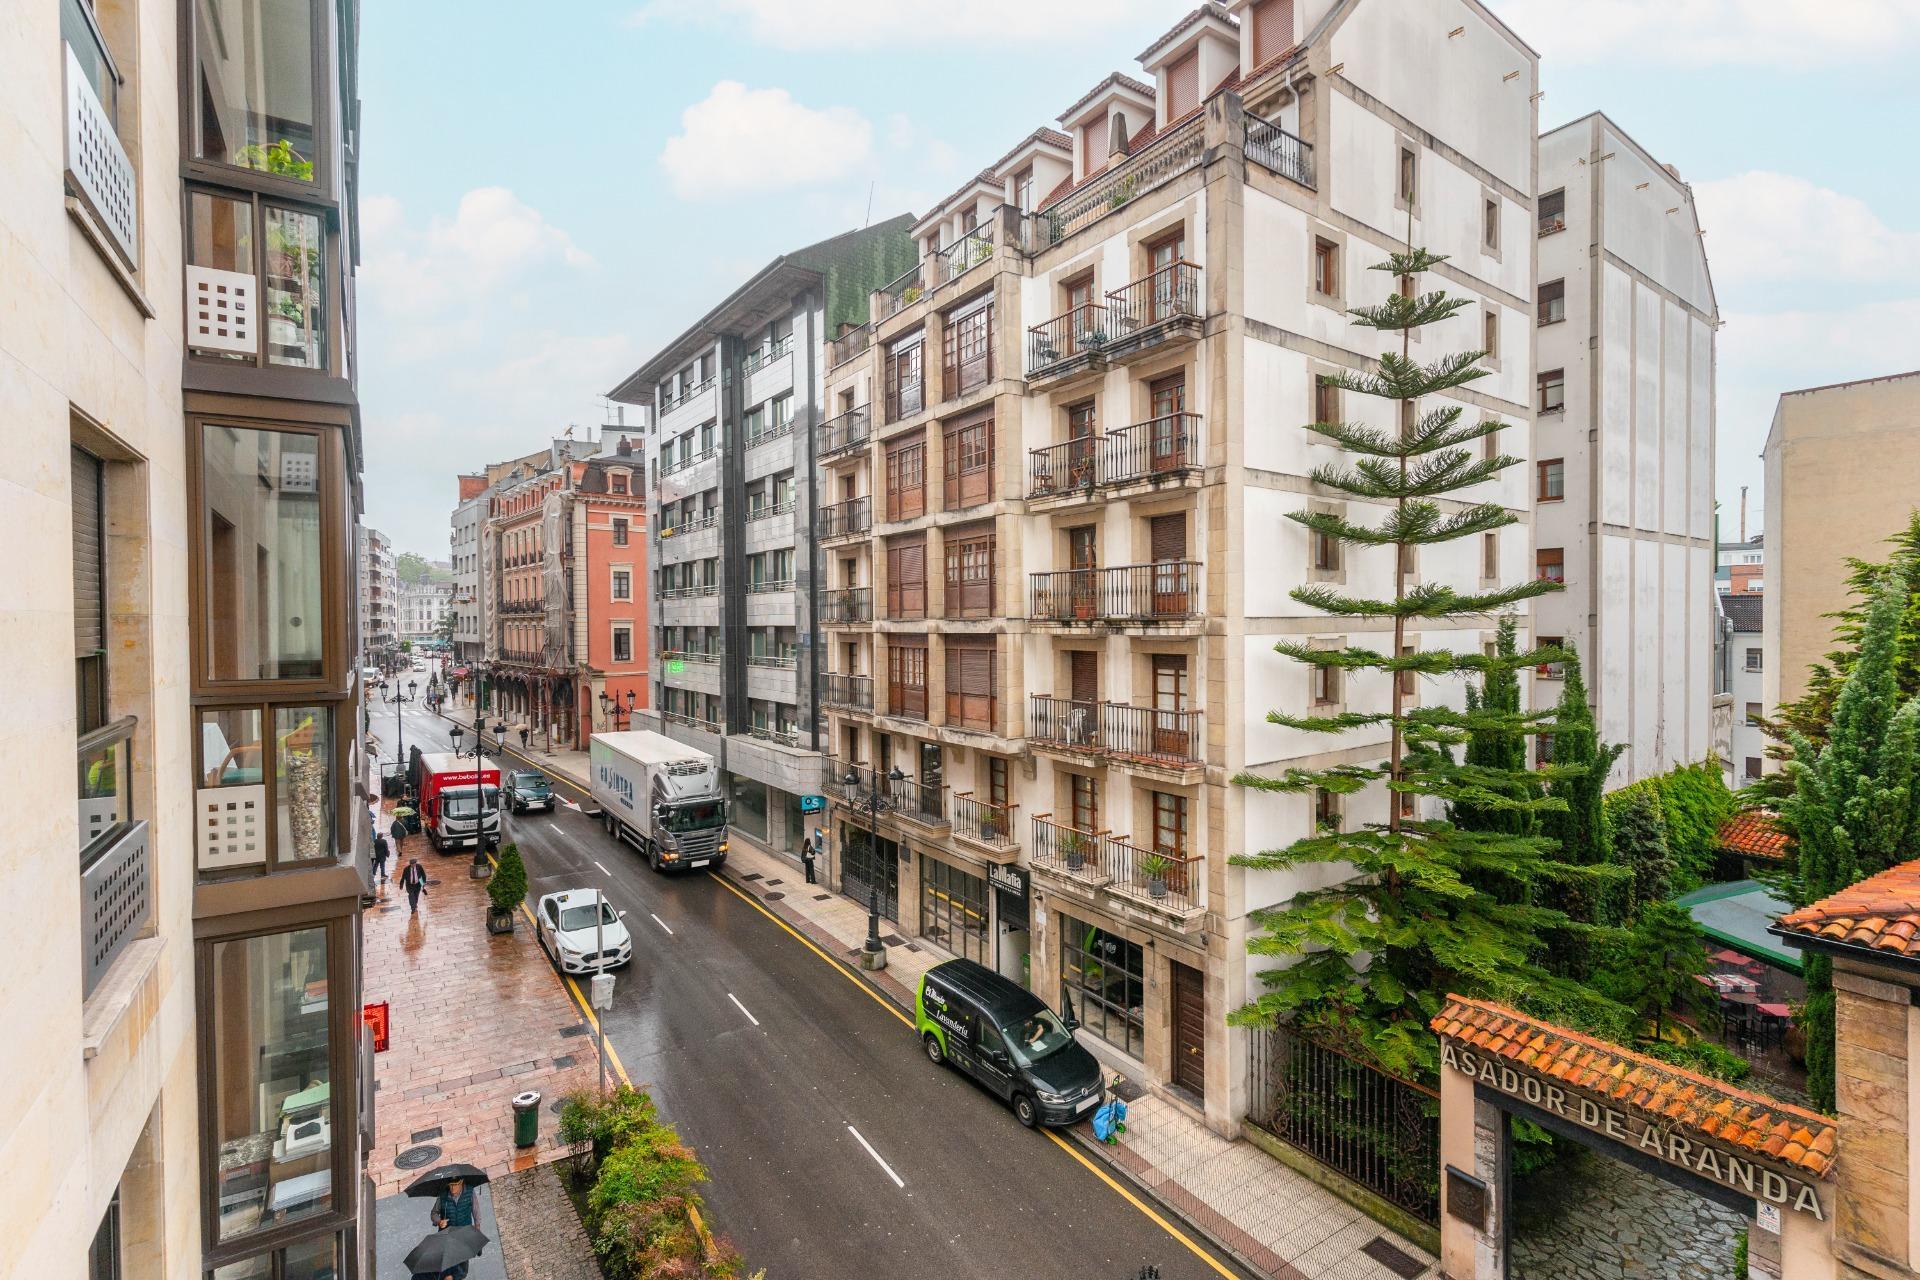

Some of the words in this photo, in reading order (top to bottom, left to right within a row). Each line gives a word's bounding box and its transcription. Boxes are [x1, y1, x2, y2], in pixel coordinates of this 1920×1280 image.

[936, 1009, 969, 1037] Lavandería
[1441, 1045, 1565, 1115] ASADOR
[1580, 1097, 1626, 1140] DE
[1639, 1125, 1823, 1220] ARANDA
